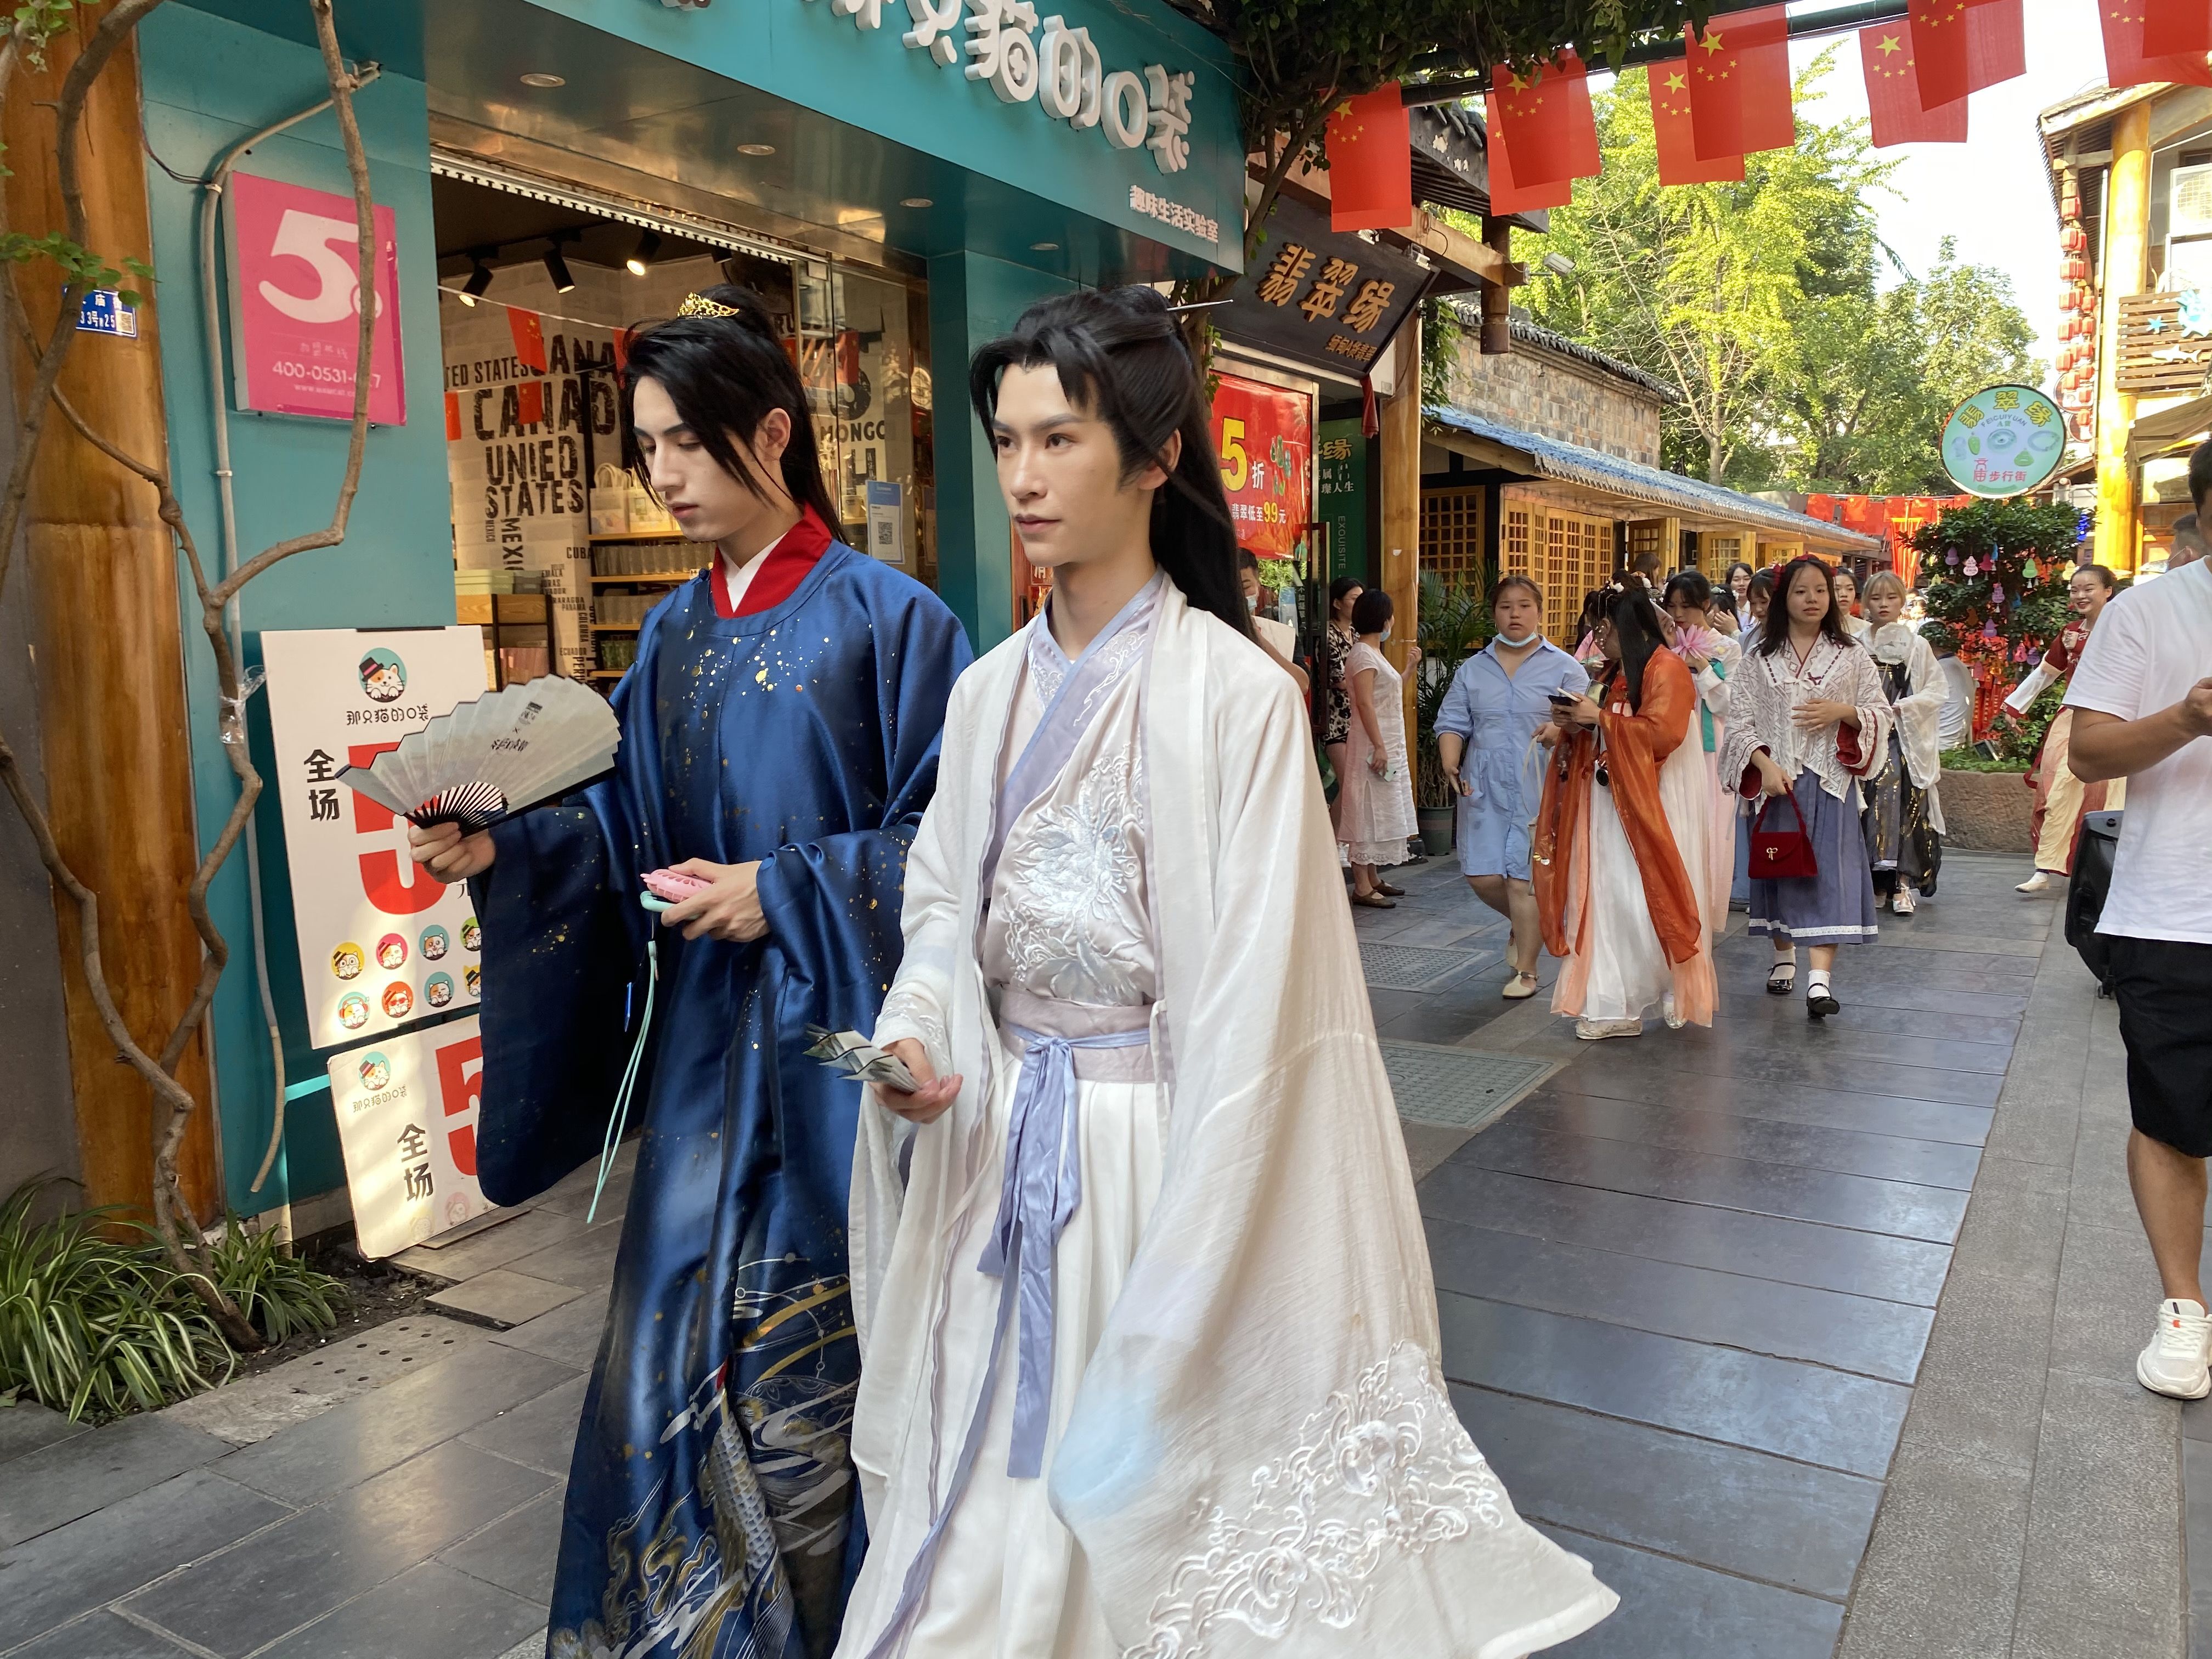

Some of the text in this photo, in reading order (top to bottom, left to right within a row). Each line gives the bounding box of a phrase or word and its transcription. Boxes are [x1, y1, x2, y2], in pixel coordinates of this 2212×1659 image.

[831, 0, 1195, 173] 只猫的口袋
[1130, 184, 1218, 243] 趣味生活实验室
[1256, 243, 1395, 333] 翡翠缘
[272, 360, 381, 388] 400-0531-7
[1958, 390, 2052, 429] 翡翠缘
[1318, 435, 1352, 460] 缘
[485, 479, 584, 518] STATES
[346, 703, 429, 726] 那只猫的口袋
[303, 749, 340, 821] 全场
[353, 1084, 407, 1113] 那只猫的口袋
[397, 1123, 434, 1201] 全场
